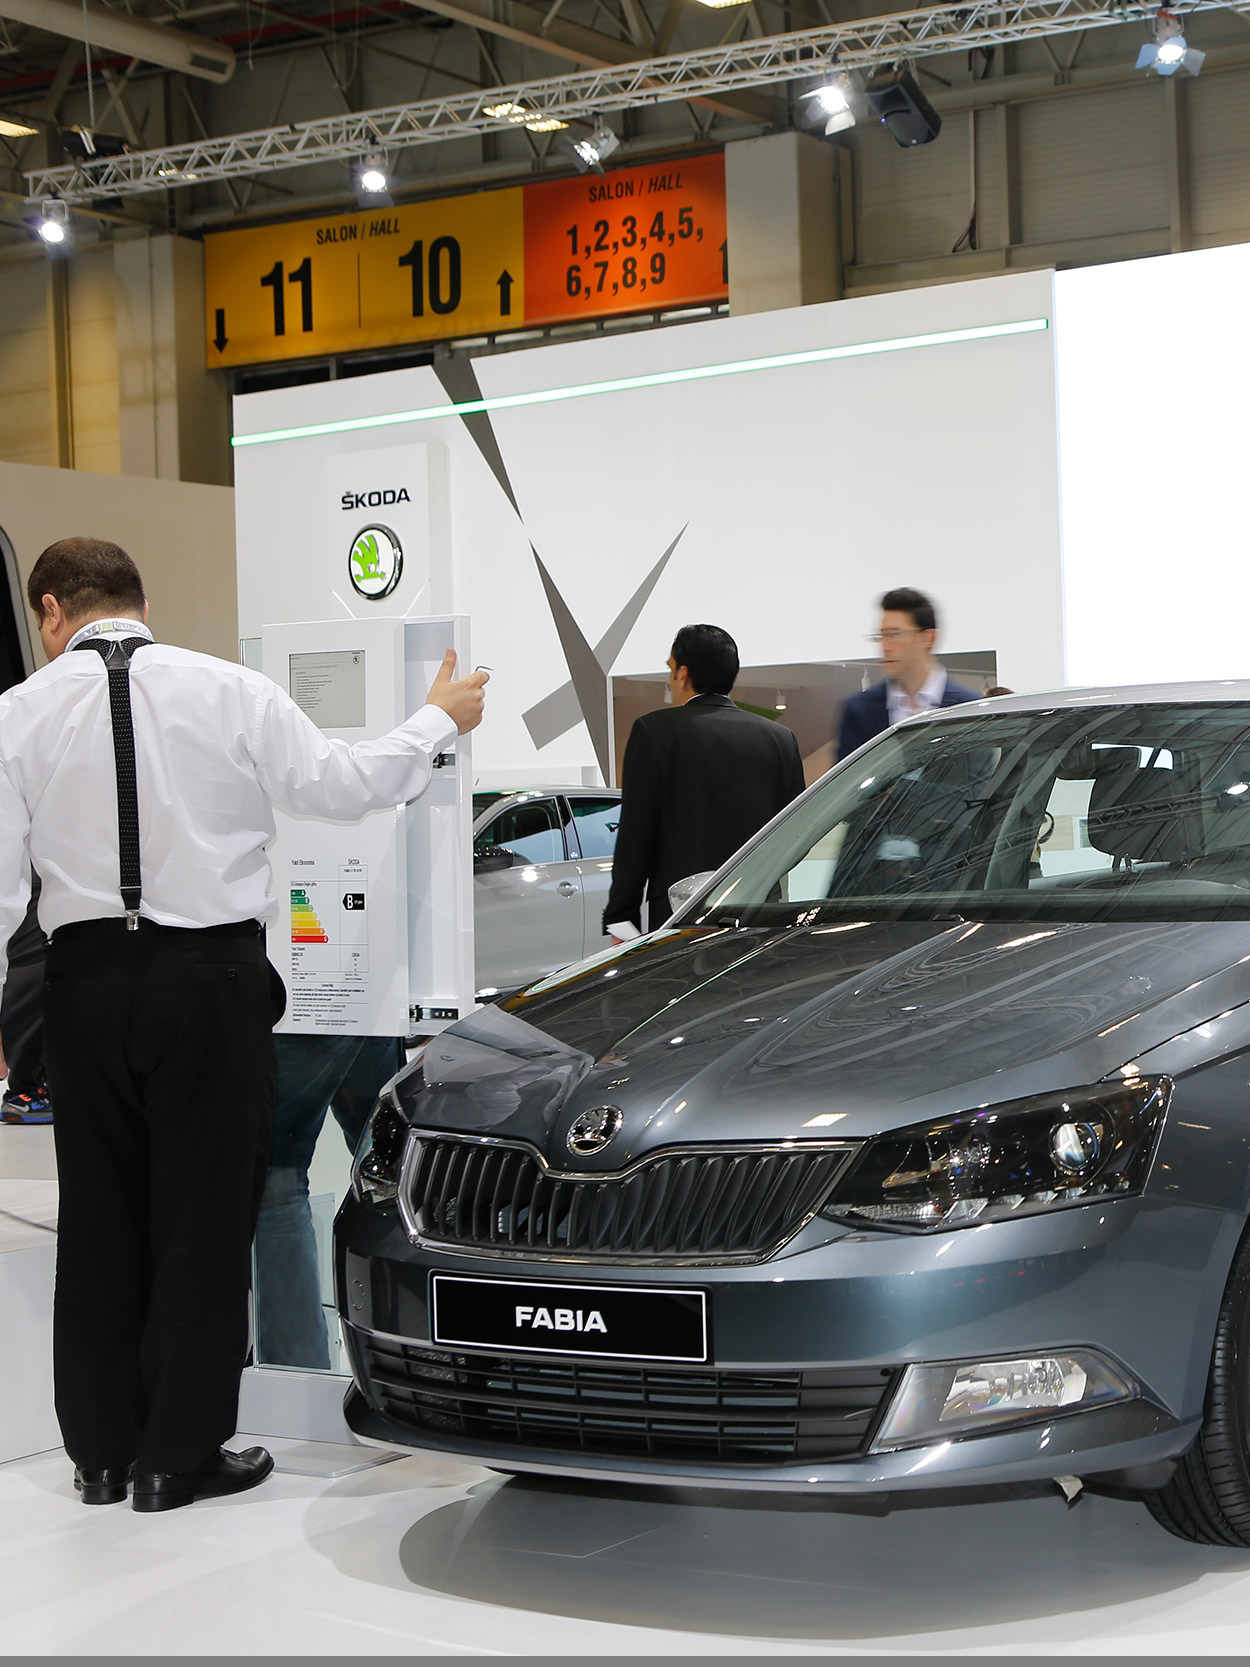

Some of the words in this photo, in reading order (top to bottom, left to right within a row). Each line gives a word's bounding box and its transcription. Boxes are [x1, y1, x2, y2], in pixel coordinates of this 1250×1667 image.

[588, 180, 634, 203] SALON
[648, 173, 683, 194] HALL
[316, 224, 358, 245] SALON
[369, 217, 401, 237] HALL
[398, 235, 462, 318] 10
[566, 252, 666, 301] 6,7,8,9
[260, 257, 314, 337] 11
[341, 488, 411, 511] ŠKODA
[515, 1305, 608, 1334] FABIA
